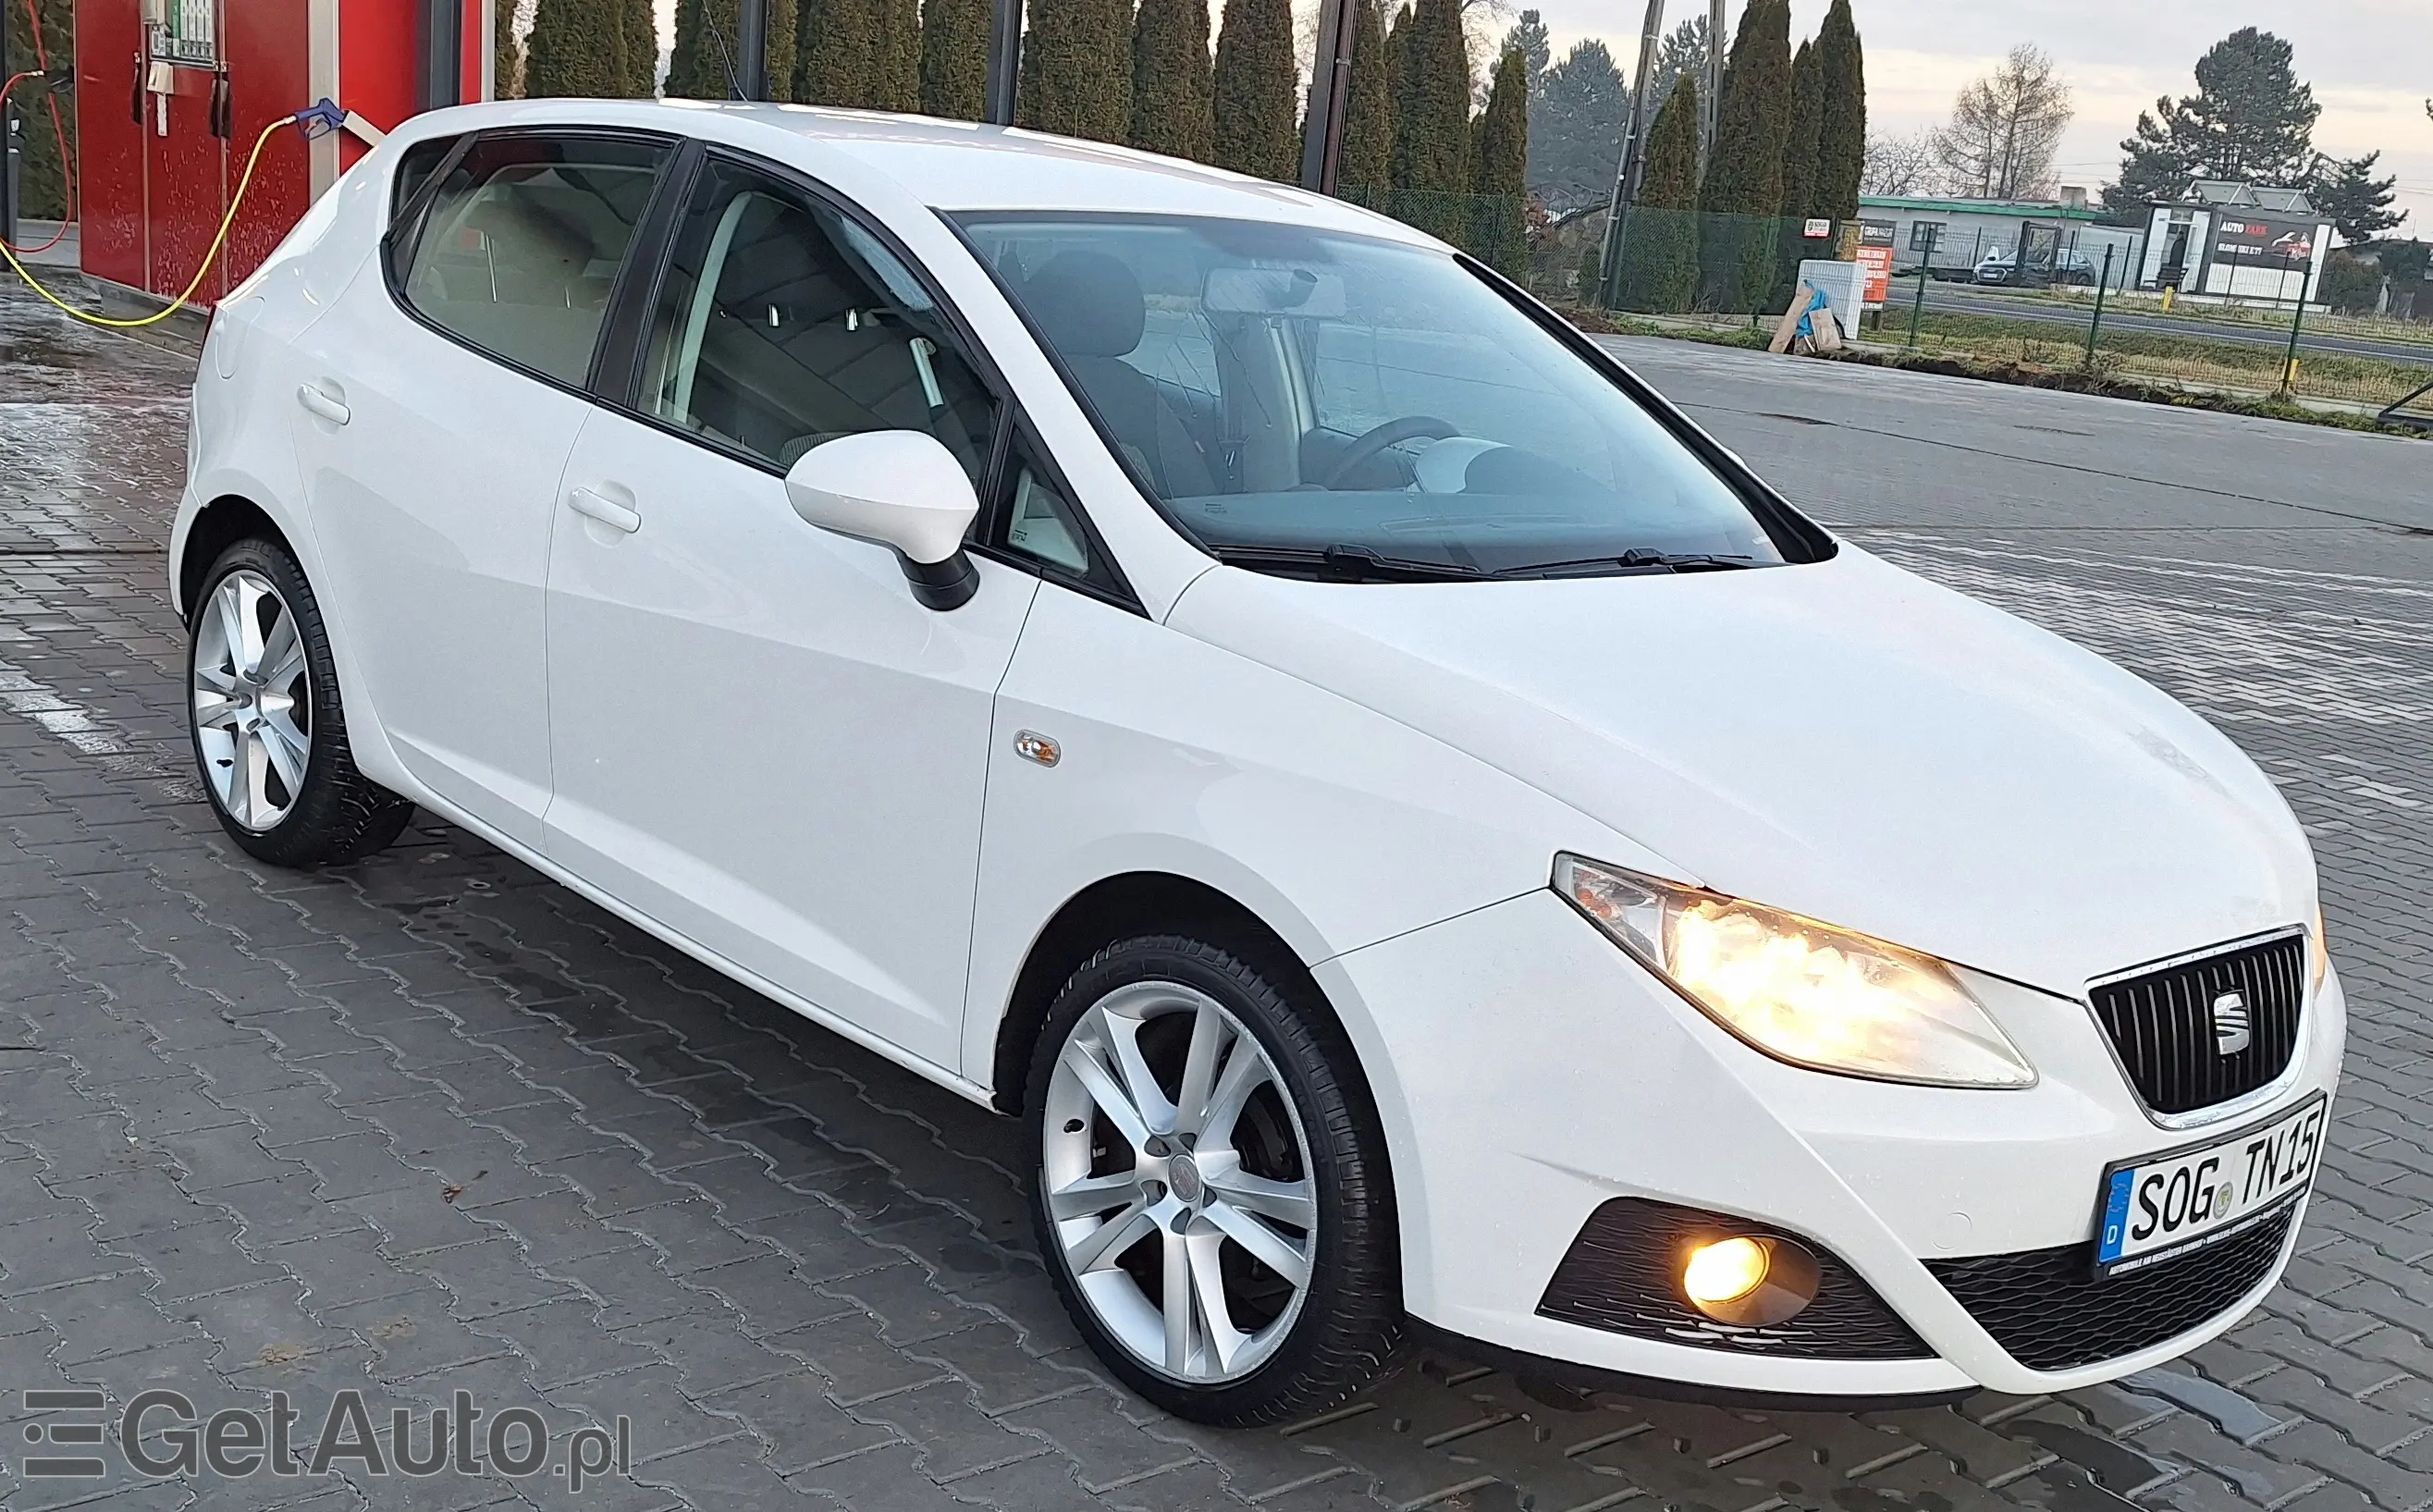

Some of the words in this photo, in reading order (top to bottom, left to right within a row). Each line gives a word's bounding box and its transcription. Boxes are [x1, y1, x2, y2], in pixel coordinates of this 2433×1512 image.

[2220, 221, 2244, 233] AUTO
[2132, 1157, 2219, 1241] SOG
[2107, 1224, 2119, 1245] D
